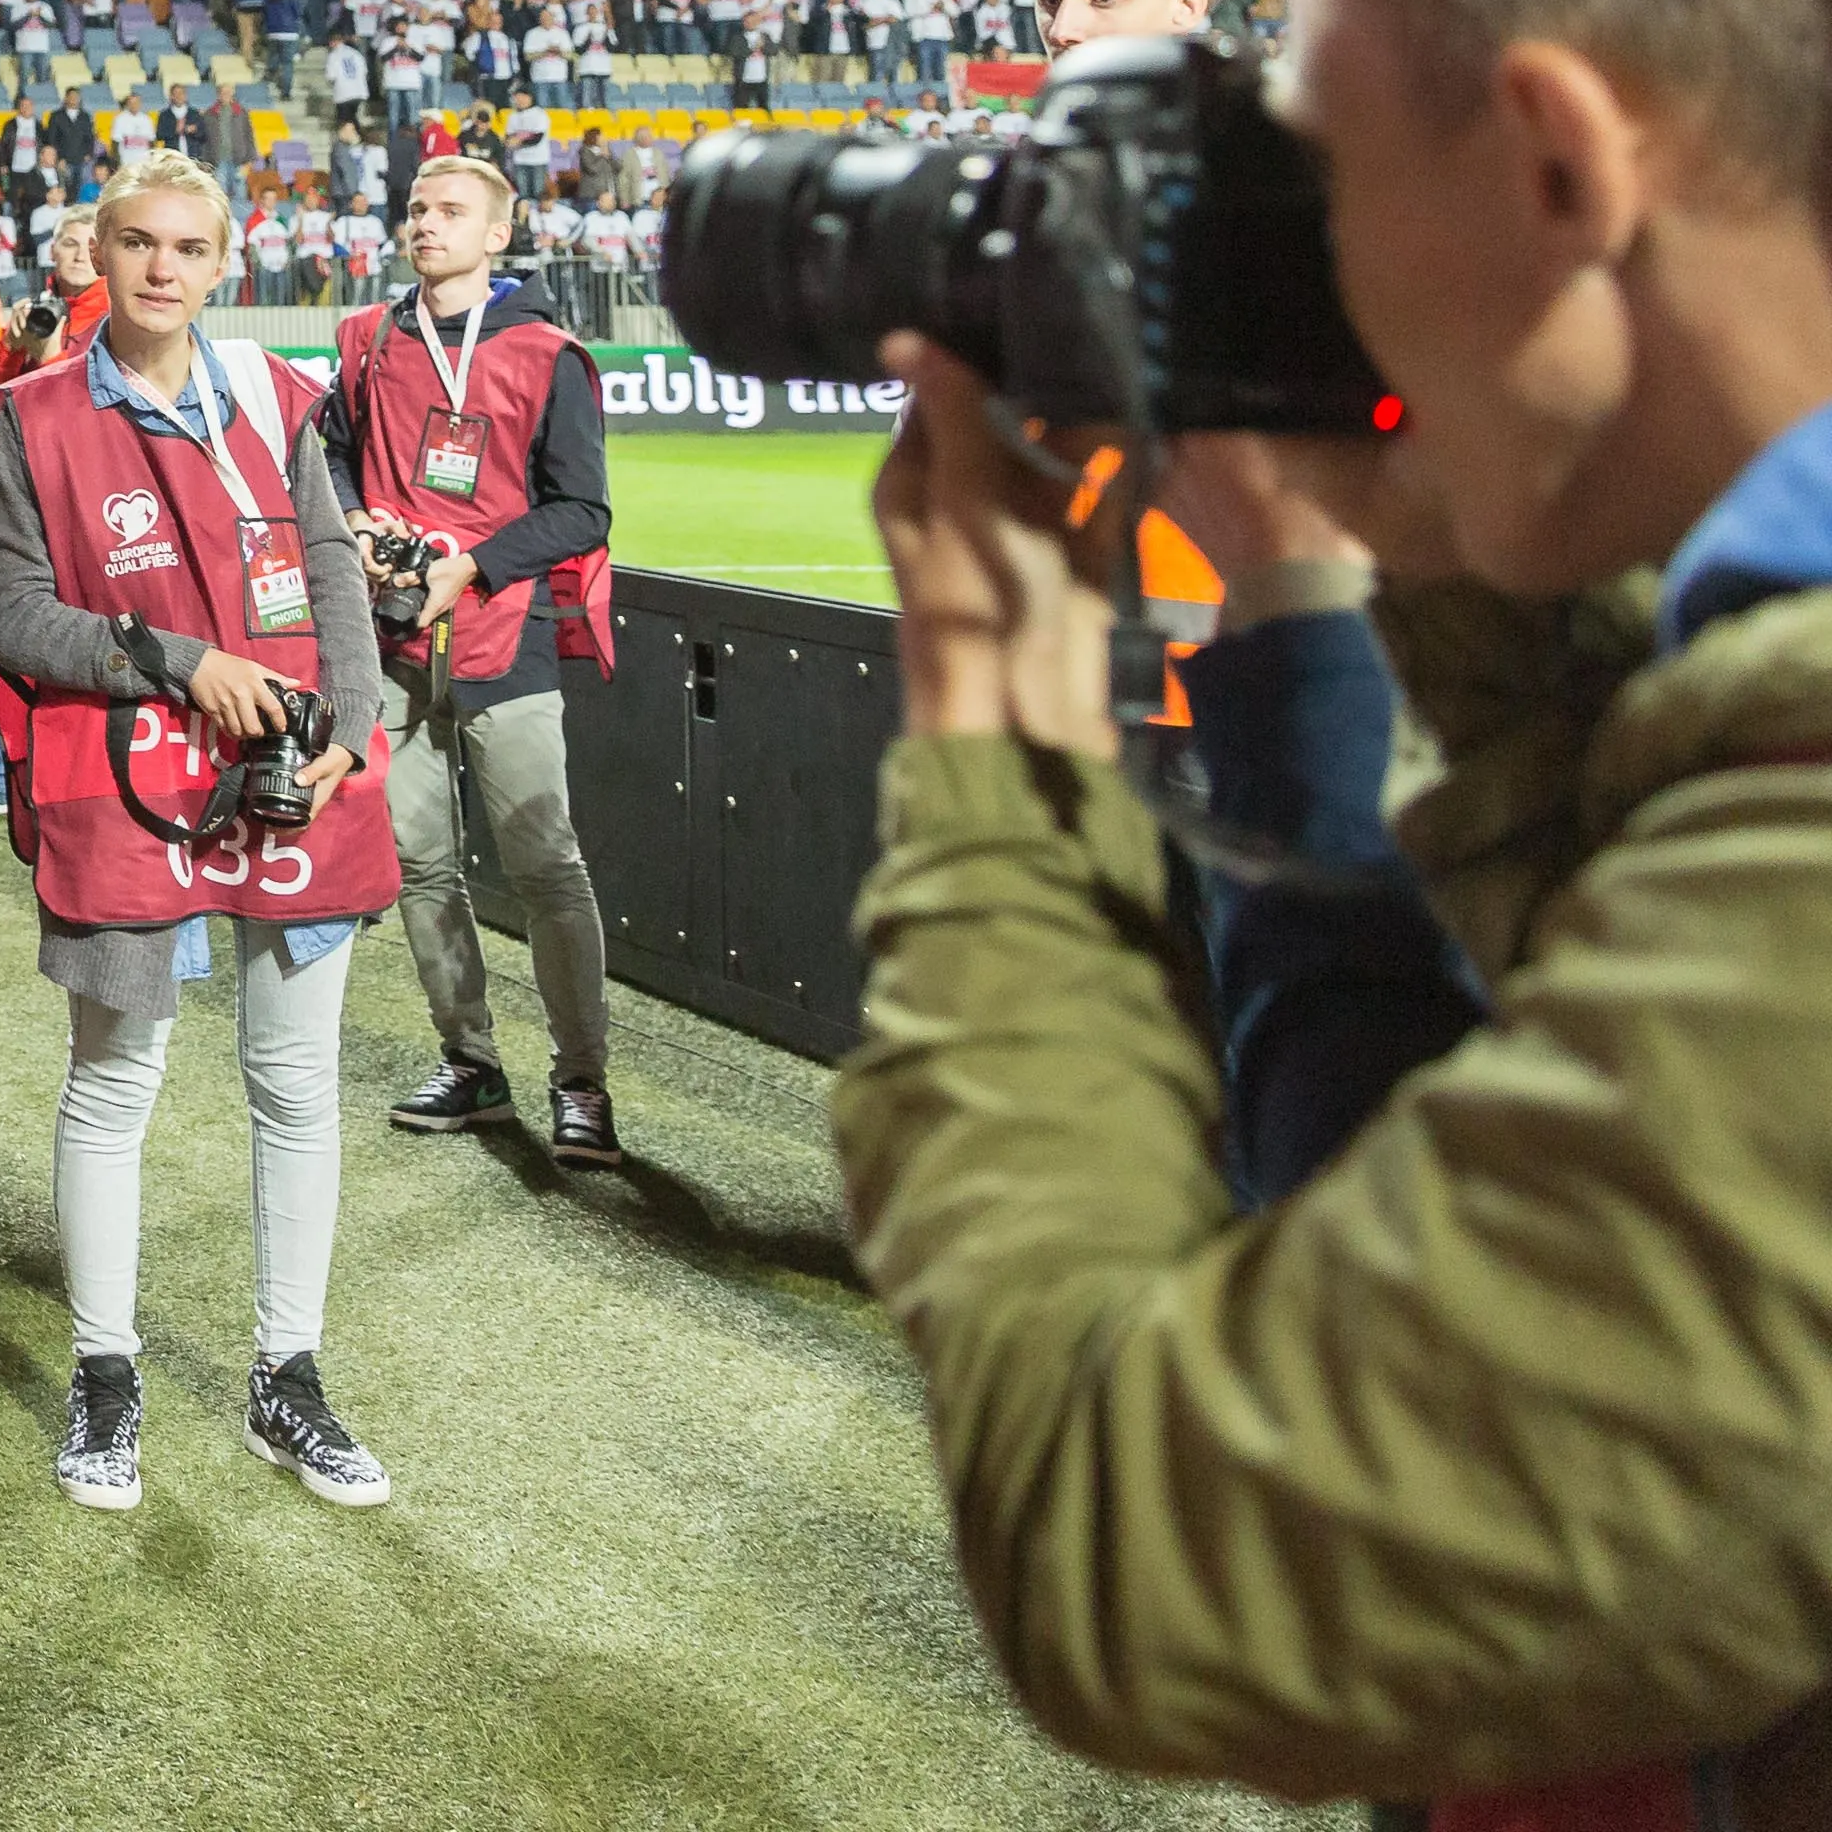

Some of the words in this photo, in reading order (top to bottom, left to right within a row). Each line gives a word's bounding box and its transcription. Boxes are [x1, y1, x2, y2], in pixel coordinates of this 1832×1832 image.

[600, 353, 766, 429] ably
[108, 541, 173, 563] EUROPEAN
[104, 553, 179, 579] QUALIFIERS
[269, 607, 304, 627] PHOTO
